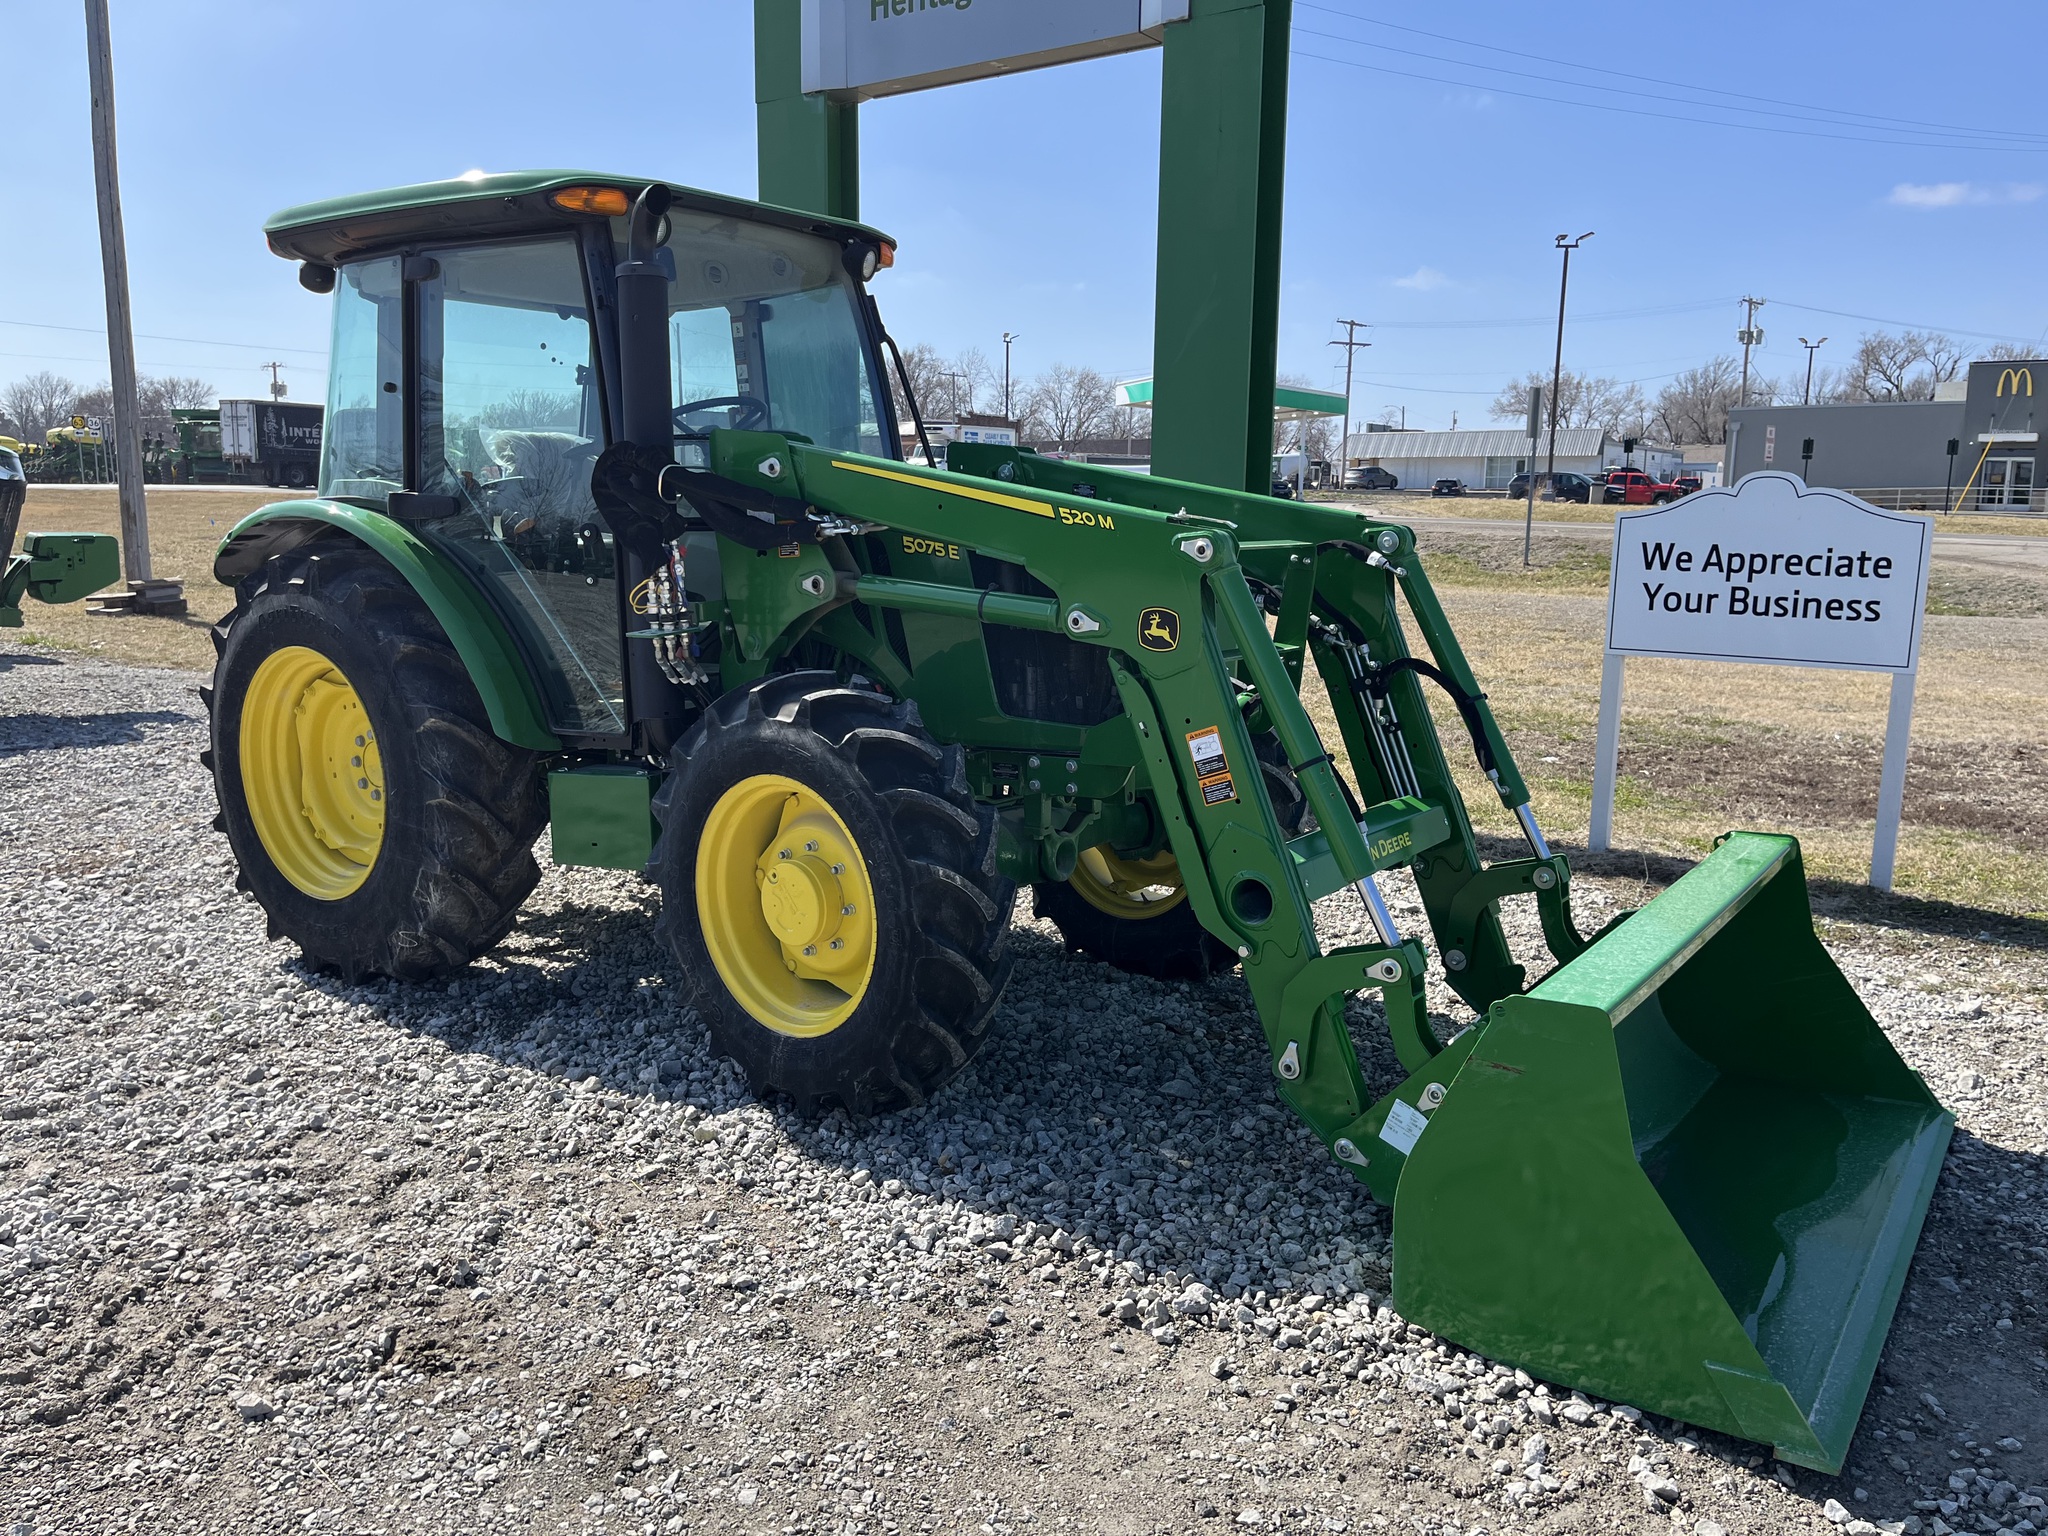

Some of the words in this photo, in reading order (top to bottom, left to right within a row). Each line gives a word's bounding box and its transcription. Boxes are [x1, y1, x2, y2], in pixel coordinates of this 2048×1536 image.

[73, 419, 84, 427] 63
[89, 419, 99, 427] 36
[289, 426, 324, 438] INTE
[1058, 507, 1096, 528] 520
[1097, 514, 1115, 531] M
[902, 535, 946, 557] 5075
[947, 544, 960, 560] E
[1641, 541, 1693, 572] We
[1701, 543, 1893, 583] Appreciate
[1642, 582, 1719, 614] Your
[1728, 585, 1881, 622] Business
[1194, 728, 1215, 738] WARNING
[1208, 775, 1228, 785] WARNING
[1378, 831, 1412, 857] DEERE
